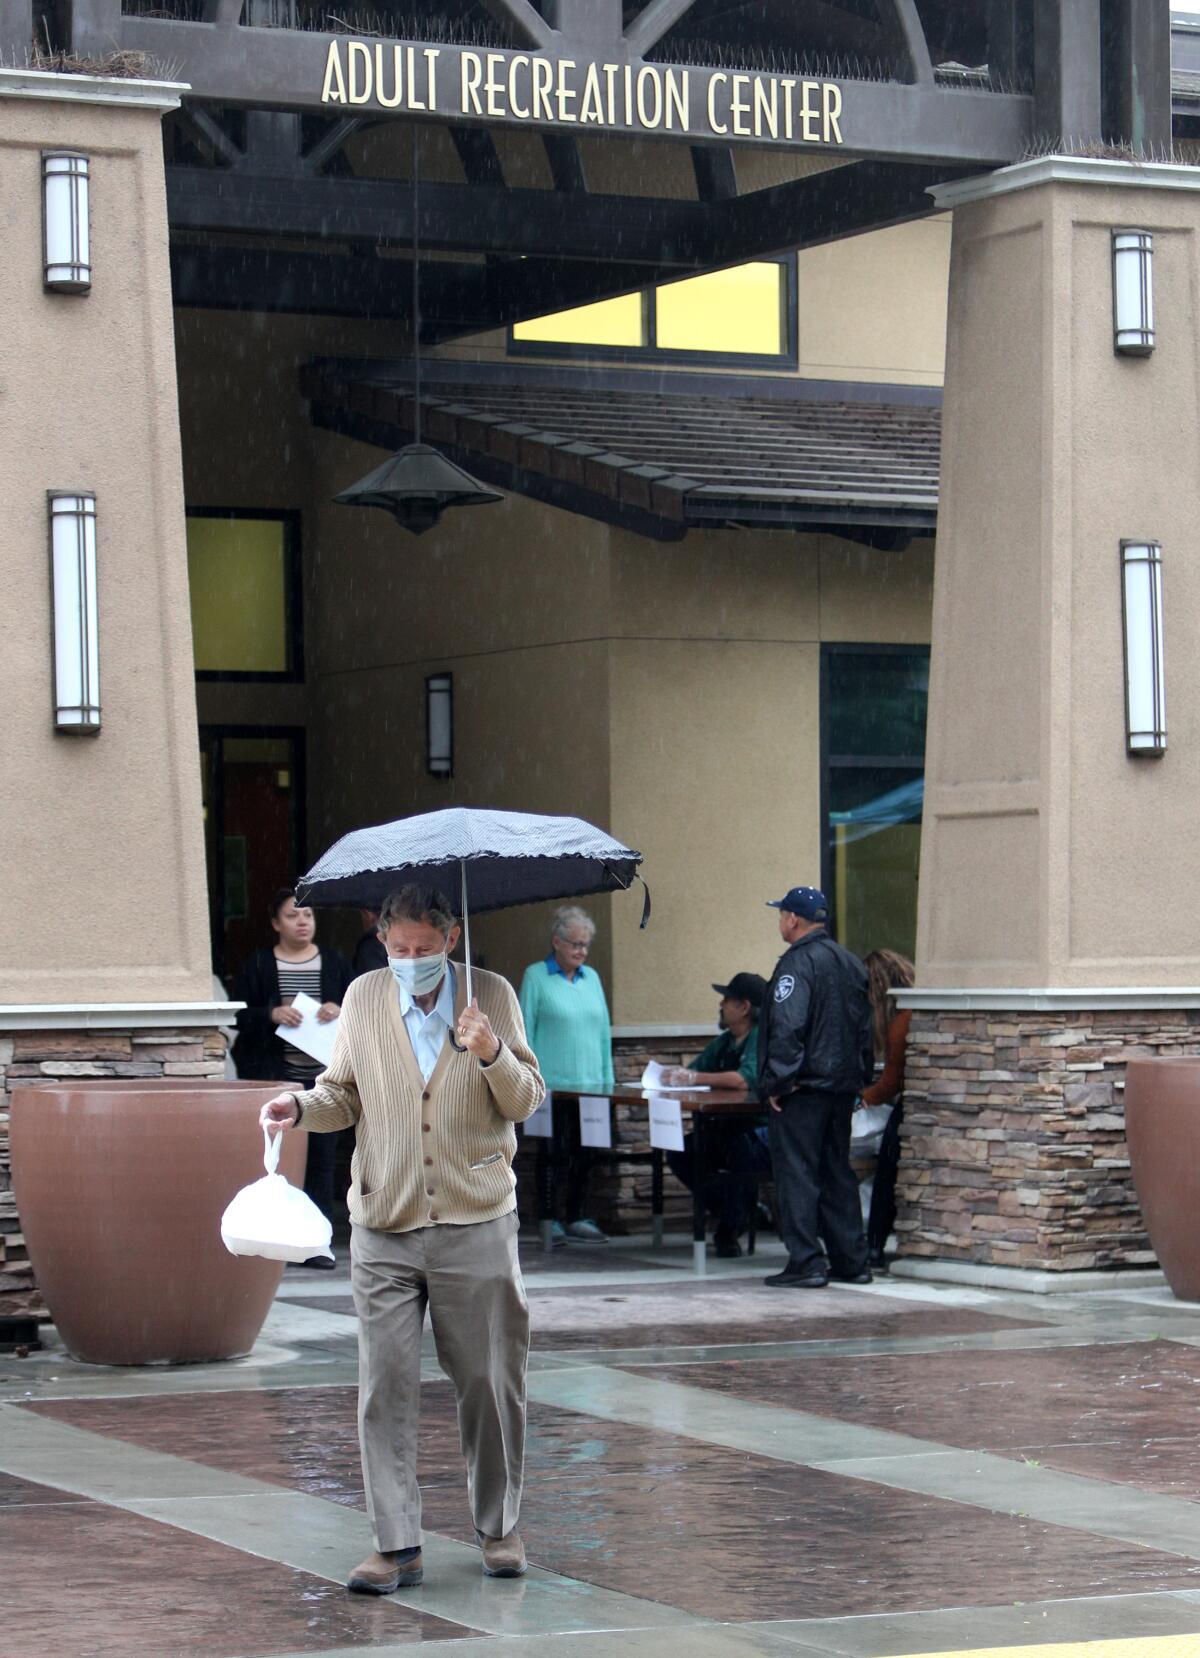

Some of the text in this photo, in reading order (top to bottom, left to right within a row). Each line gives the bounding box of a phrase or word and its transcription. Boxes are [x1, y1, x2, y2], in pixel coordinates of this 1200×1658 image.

[321, 39, 844, 144] ADULT RECREATION CENTER
